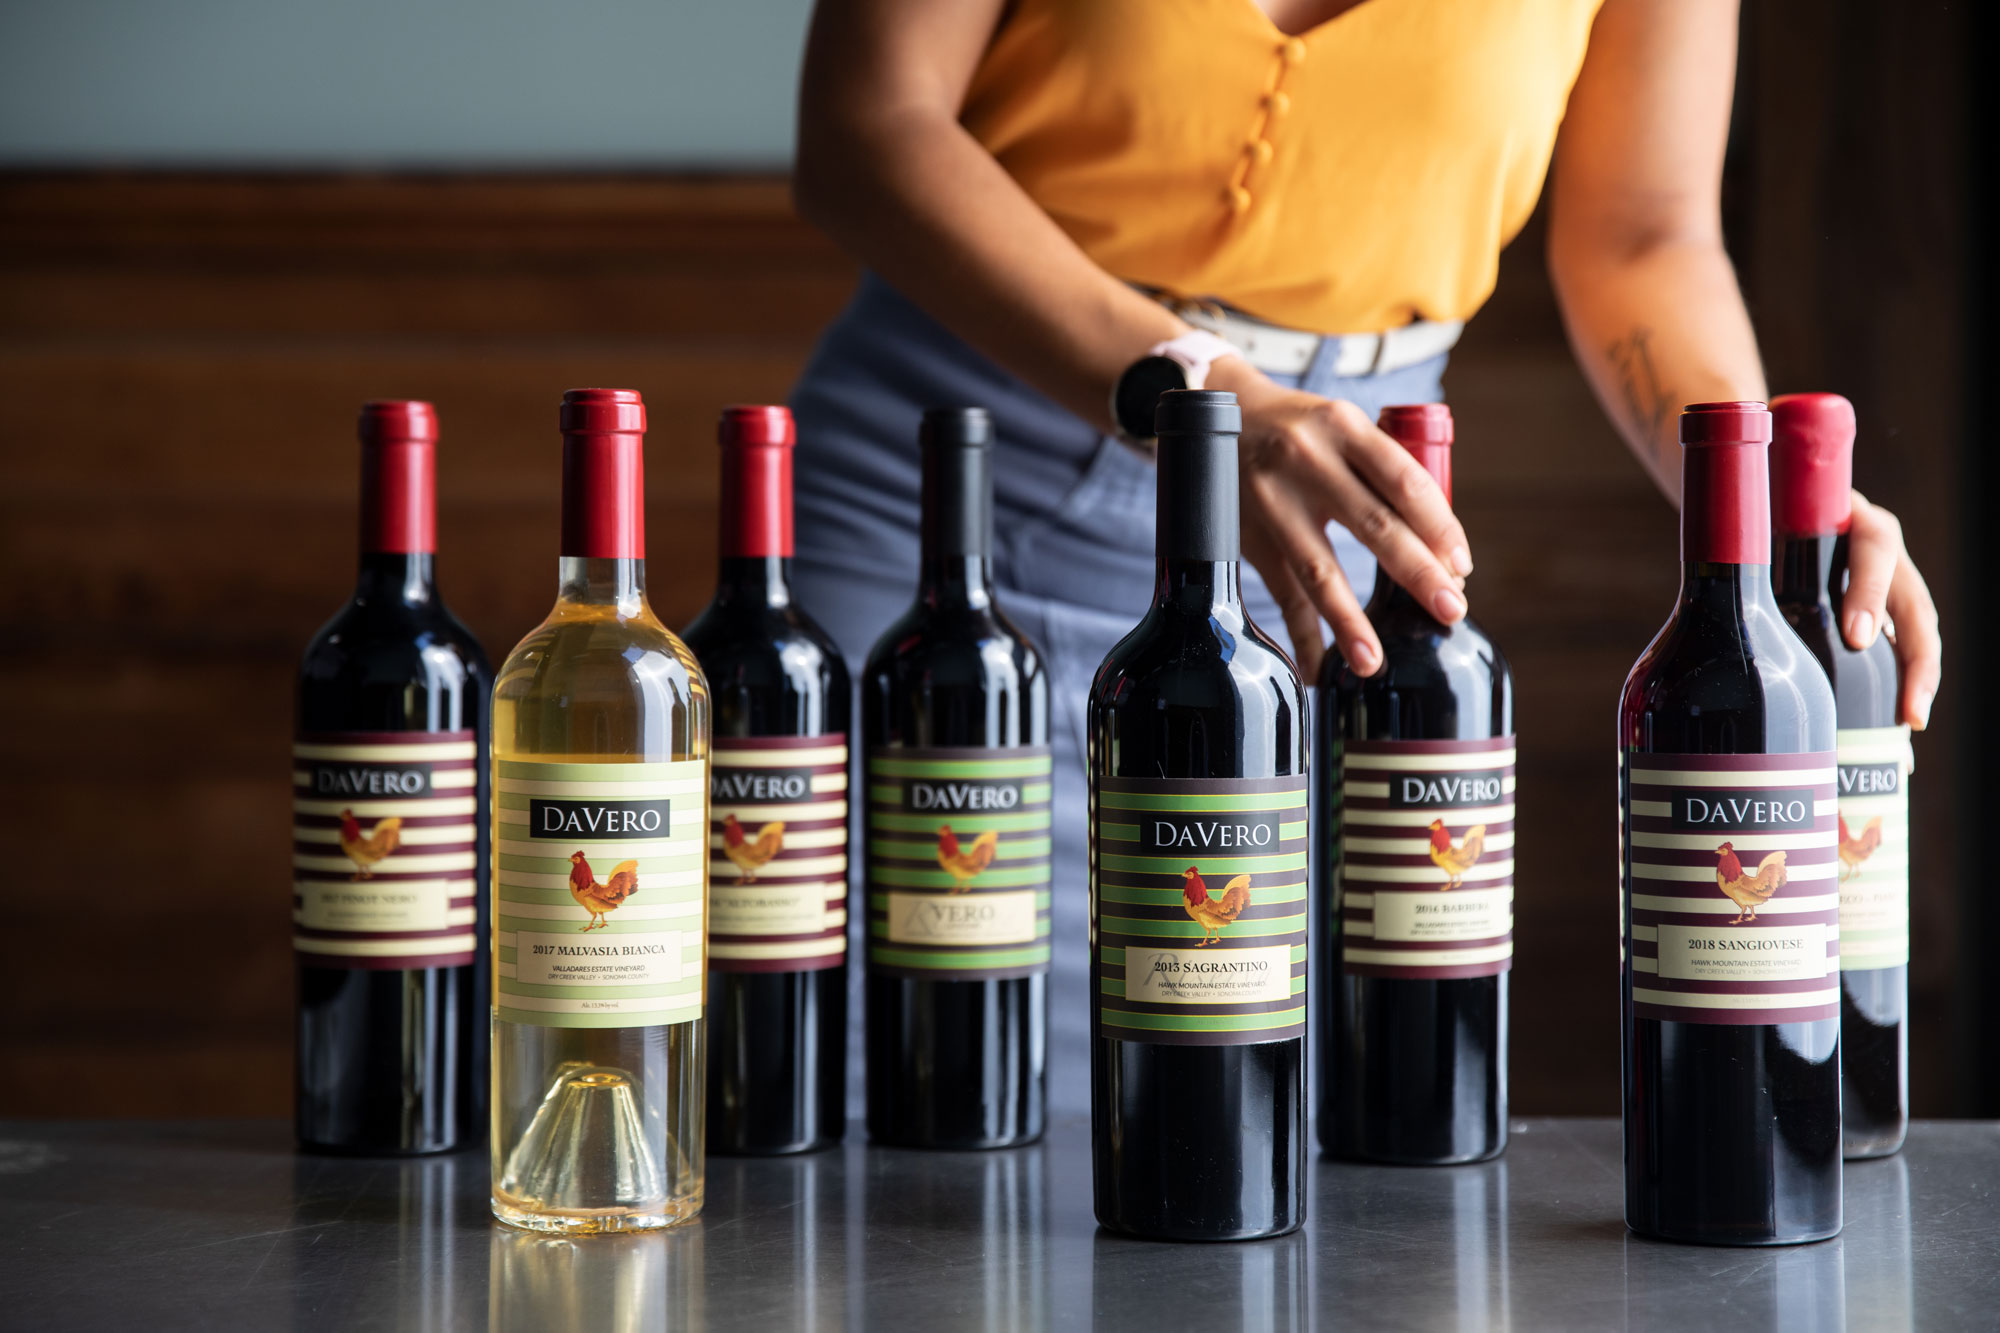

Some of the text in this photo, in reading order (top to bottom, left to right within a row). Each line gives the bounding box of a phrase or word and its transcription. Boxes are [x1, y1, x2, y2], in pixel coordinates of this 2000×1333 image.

[1838, 767, 1897, 793] VERO
[533, 944, 666, 956] 2017 MALVASIA BIANCA
[1688, 938, 1804, 951] 2018 SANGIOVESE
[552, 965, 591, 973] VALLADARES
[591, 965, 614, 973] ESTATE
[1154, 960, 1268, 973] 2013 SAGRANTINO
[1691, 959, 1712, 967] HAWK
[1158, 981, 1178, 989] HAWK
[1237, 980, 1266, 988] VINEYARD
